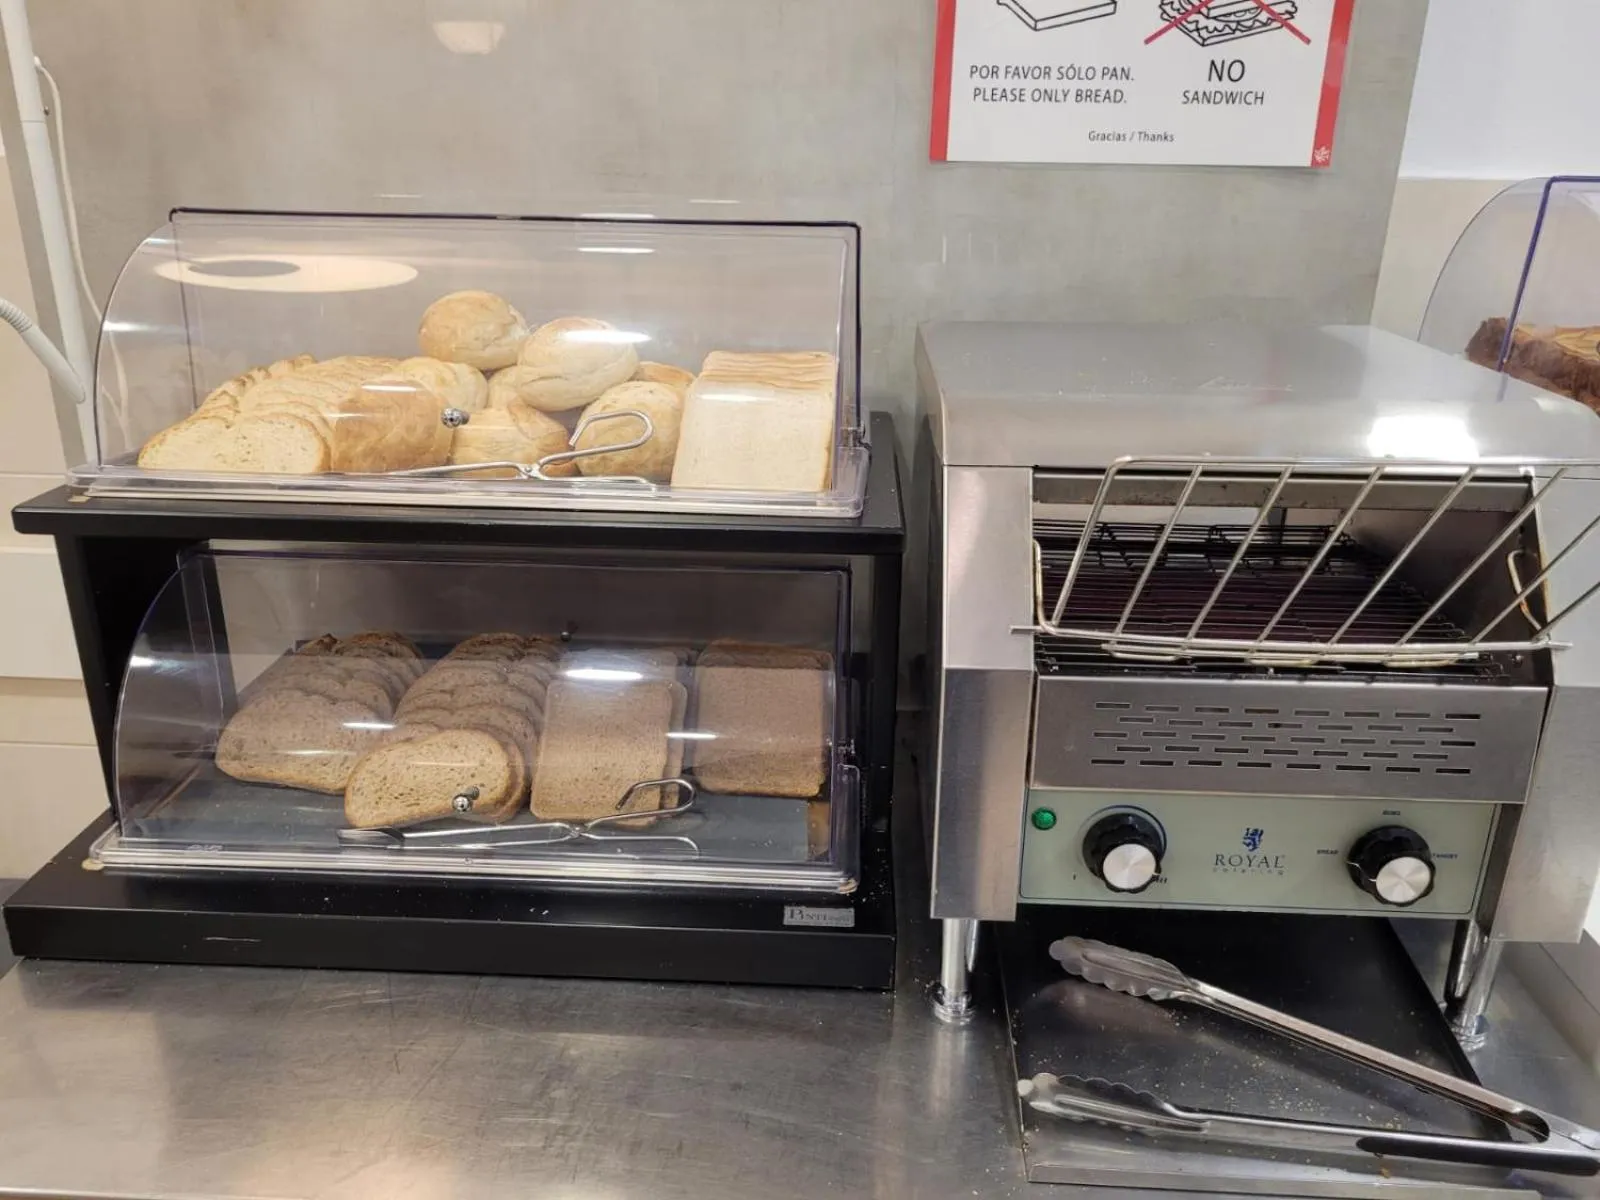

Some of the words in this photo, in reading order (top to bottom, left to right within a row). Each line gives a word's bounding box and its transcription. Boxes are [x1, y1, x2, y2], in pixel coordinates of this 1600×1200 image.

[969, 65, 1000, 80] POR
[1004, 65, 1051, 80] FAVOR
[1056, 63, 1097, 81] SÓLO
[1101, 66, 1135, 81] PAN.
[1208, 59, 1246, 83] NO
[973, 87, 1026, 102] PLEASE
[1031, 88, 1070, 103] ONLY
[1074, 89, 1127, 104] BREAD.
[1182, 90, 1265, 106] SANDWICH
[1088, 130, 1127, 142] Gracias
[1138, 131, 1175, 142] Thanks
[1214, 854, 1285, 868] ROYAL
